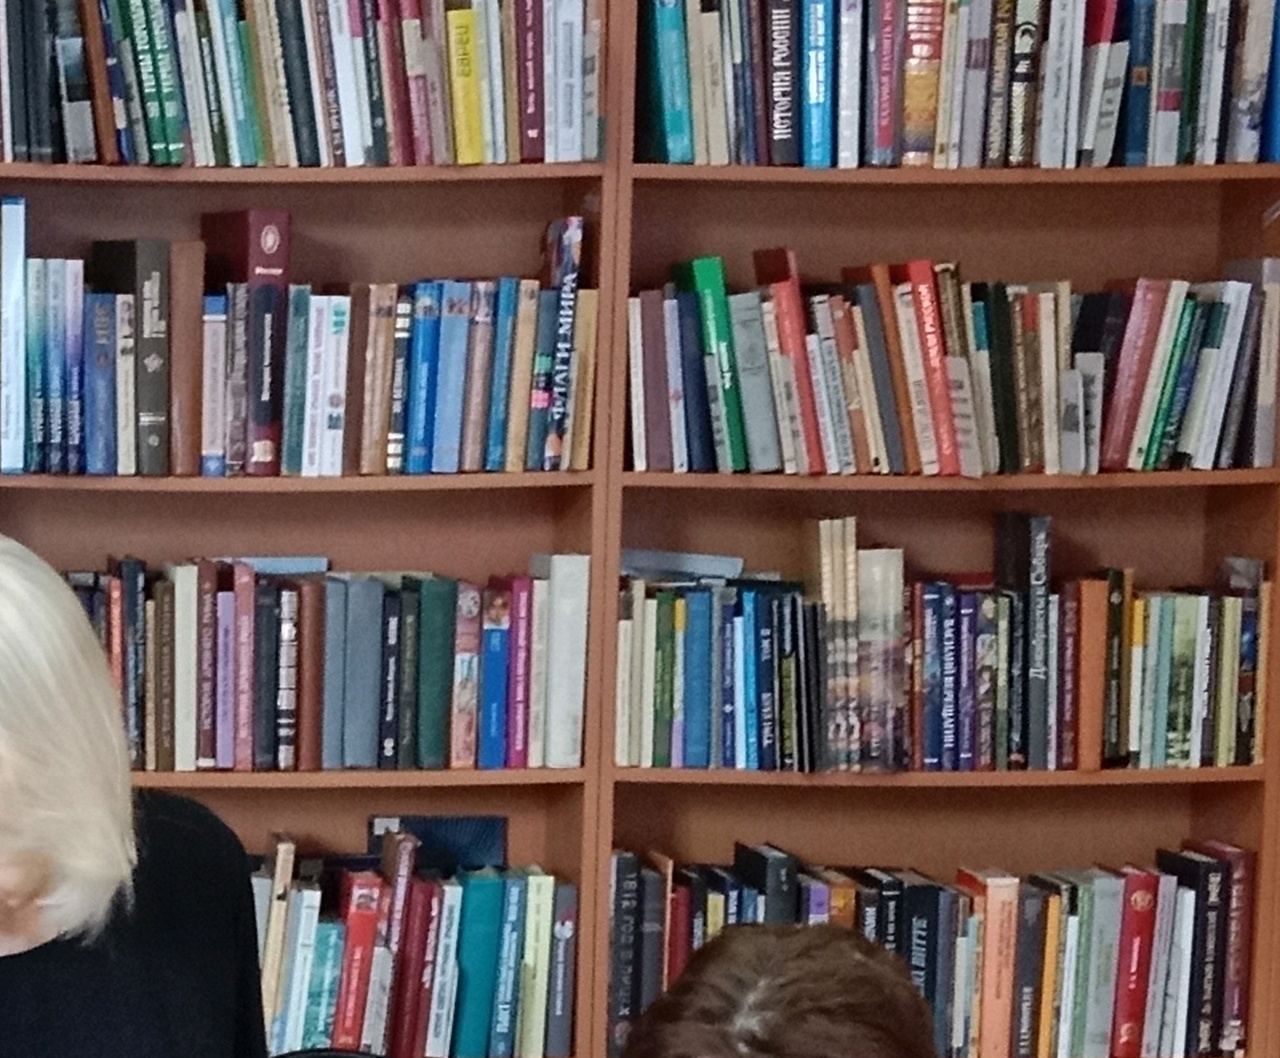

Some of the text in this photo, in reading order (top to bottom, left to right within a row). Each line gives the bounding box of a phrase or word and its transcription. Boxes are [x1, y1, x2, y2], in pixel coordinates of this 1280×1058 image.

[771, 9, 792, 141] ИСТОРИЯ РОССИИ
[553, 272, 577, 420] ФЛАГИ МИРА
[1030, 532, 1048, 585] Сибирь
[942, 677, 955, 748] ВЕРЕЩАГИН
